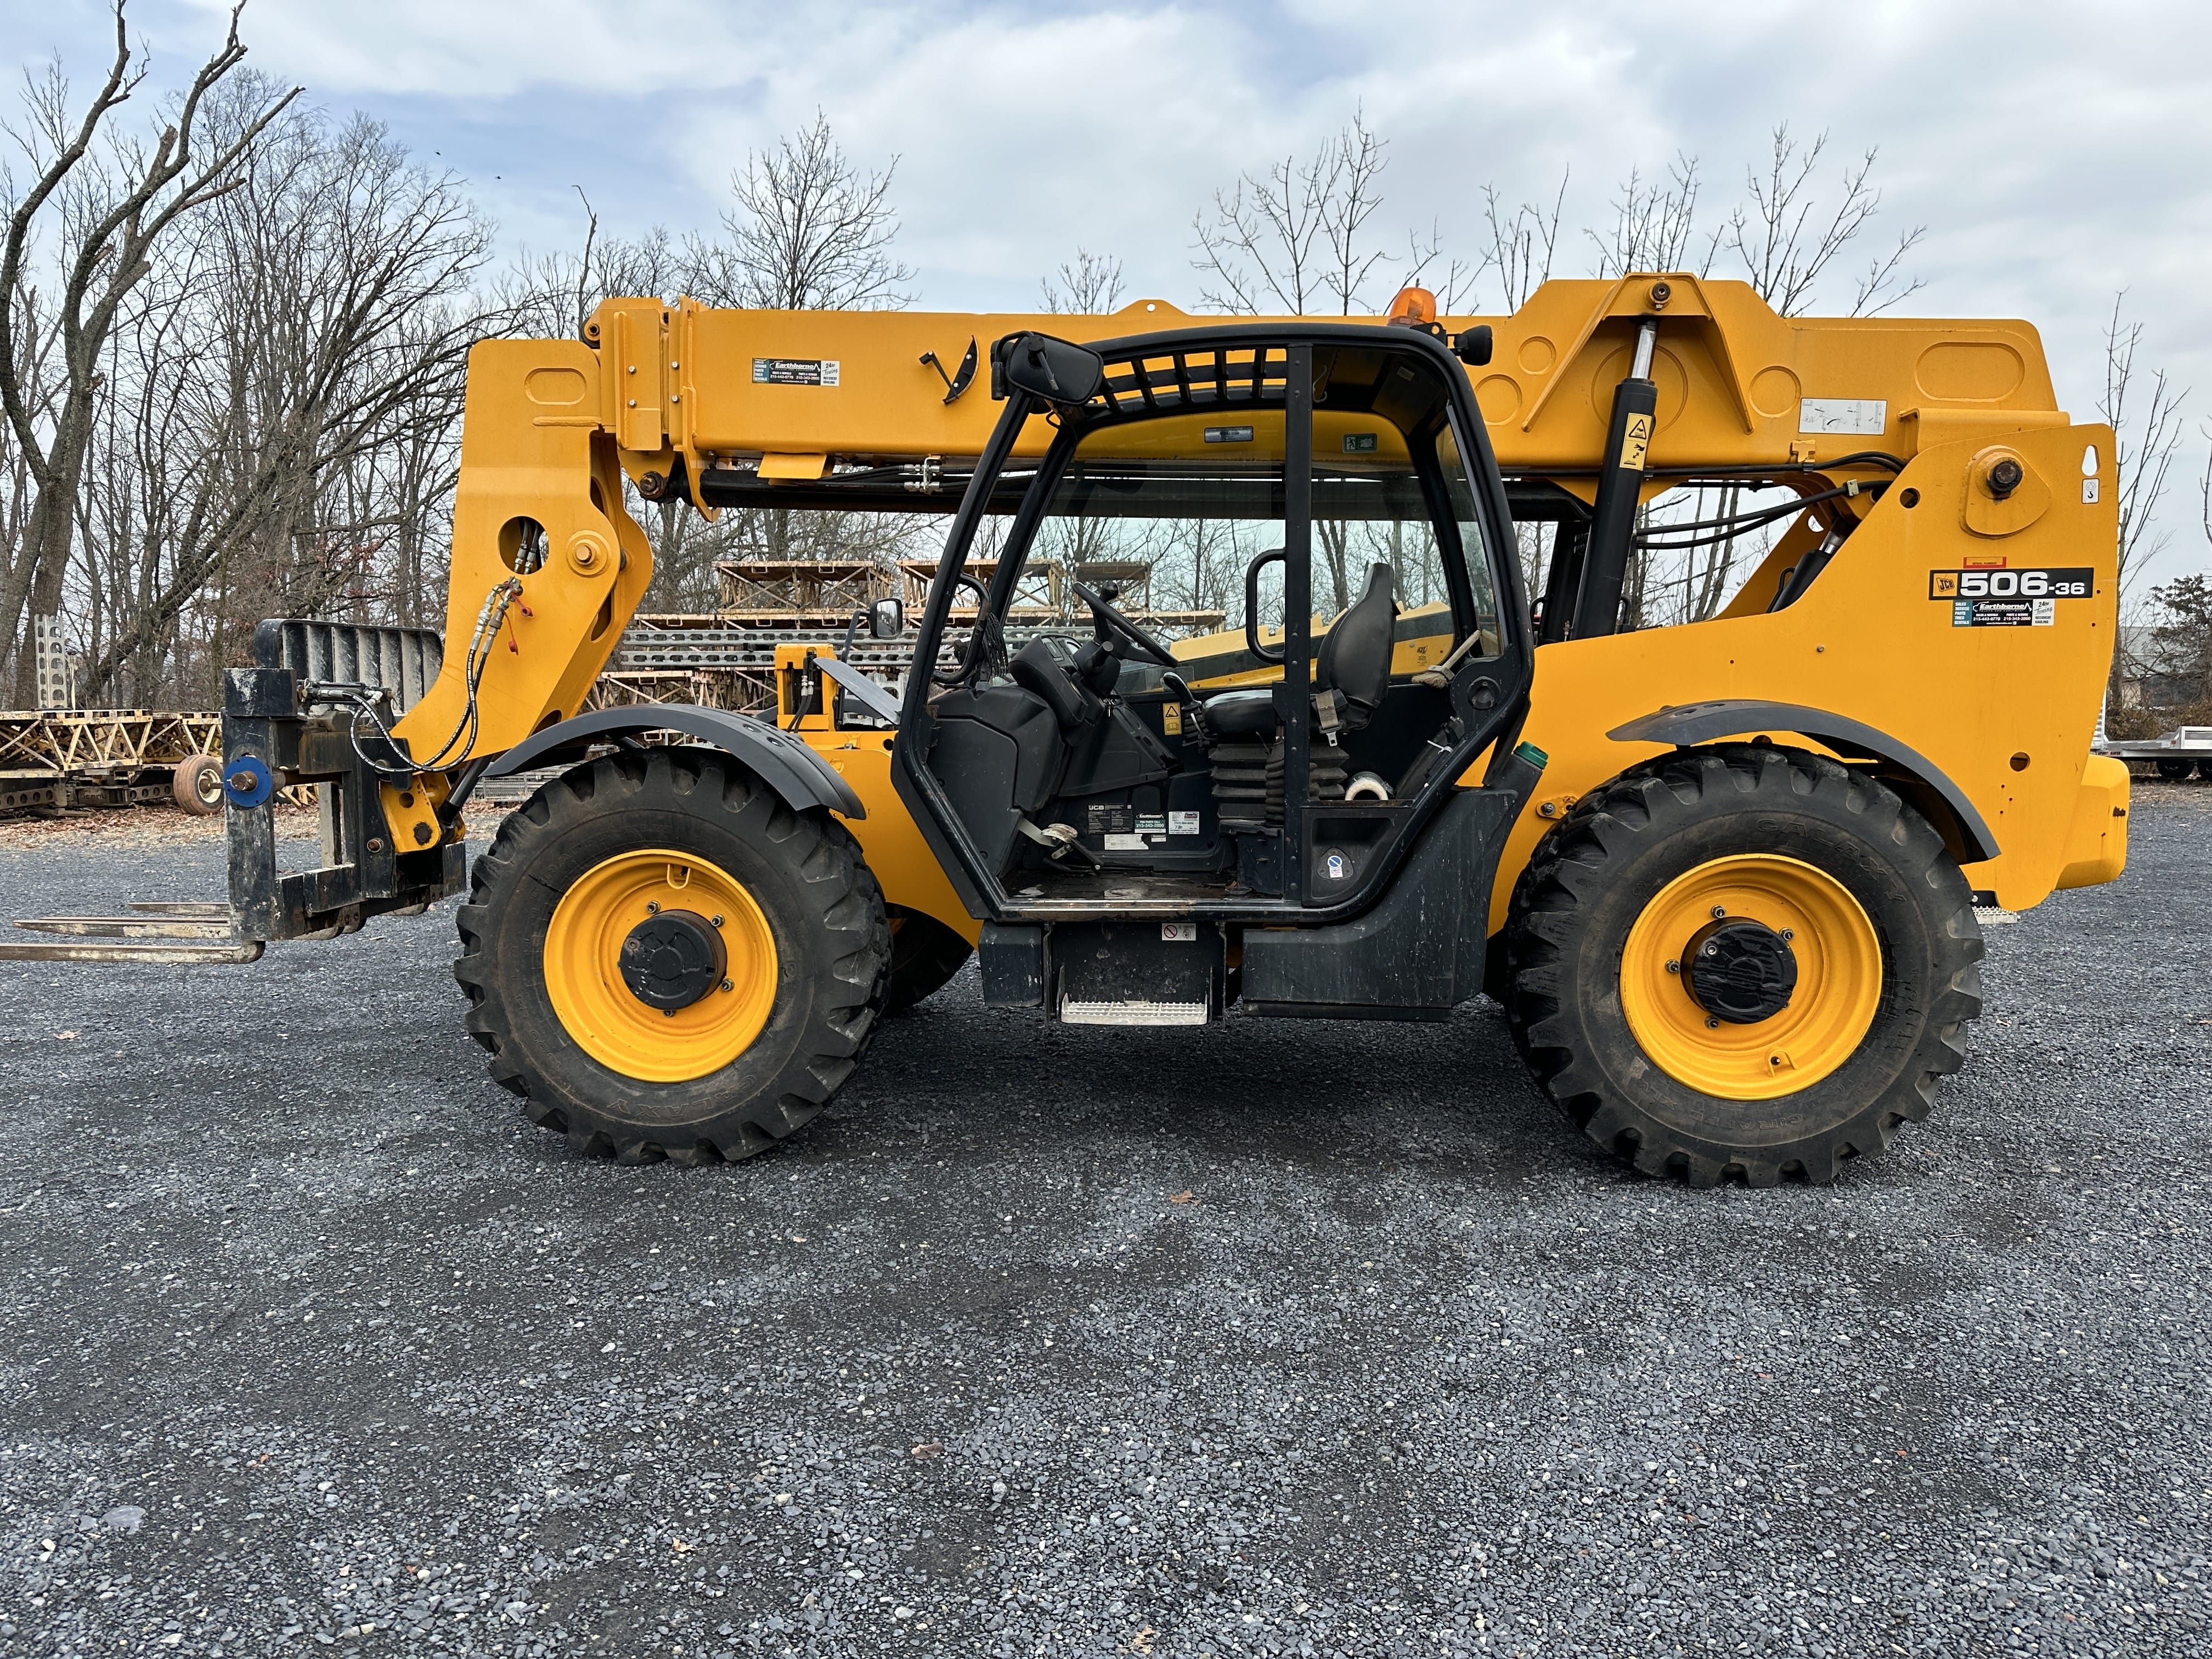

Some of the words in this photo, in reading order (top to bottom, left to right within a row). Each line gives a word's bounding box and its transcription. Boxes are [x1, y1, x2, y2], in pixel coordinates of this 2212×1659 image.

[1939, 579, 1954, 590] JCB
[1960, 572, 2085, 596] 506-36
[1756, 817, 1907, 901] GALAXY
[607, 1074, 758, 1119] GALAXY
[1688, 1110, 1804, 1132] GIRAFFE
